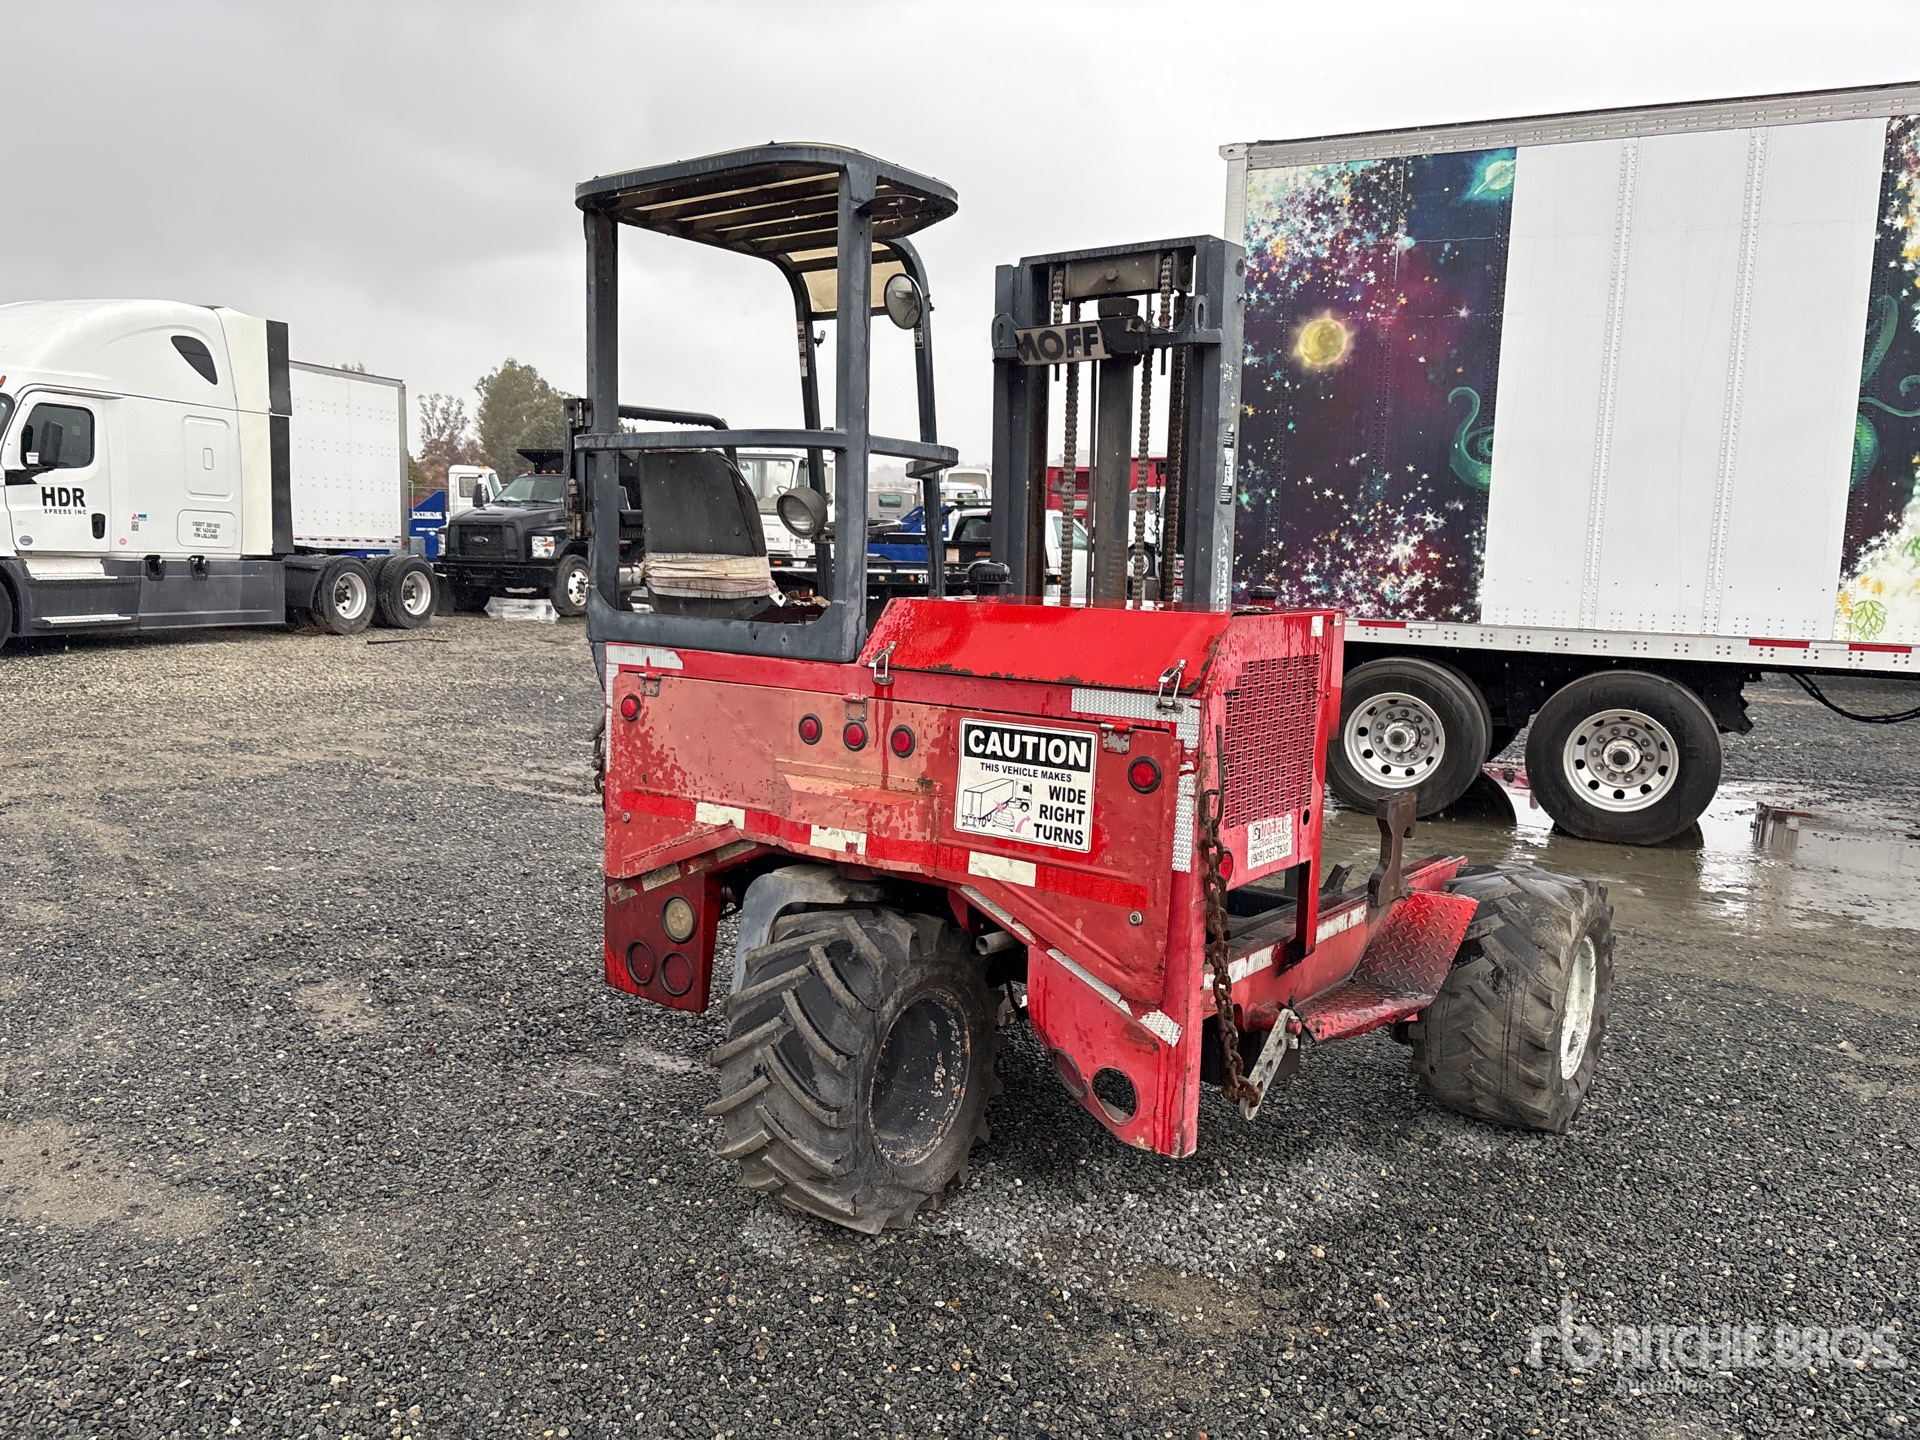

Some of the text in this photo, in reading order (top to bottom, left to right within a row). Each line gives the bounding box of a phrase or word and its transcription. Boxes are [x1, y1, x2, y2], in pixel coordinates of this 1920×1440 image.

[41, 486, 86, 507] HDR
[917, 574, 929, 584] 31
[968, 729, 1087, 767] CAUTION
[980, 762, 1072, 782] THIS VEHICLE MAKES
[1049, 785, 1086, 805] WIDE
[1039, 804, 1085, 825] RIGHT
[1034, 823, 1083, 845] TURNS
